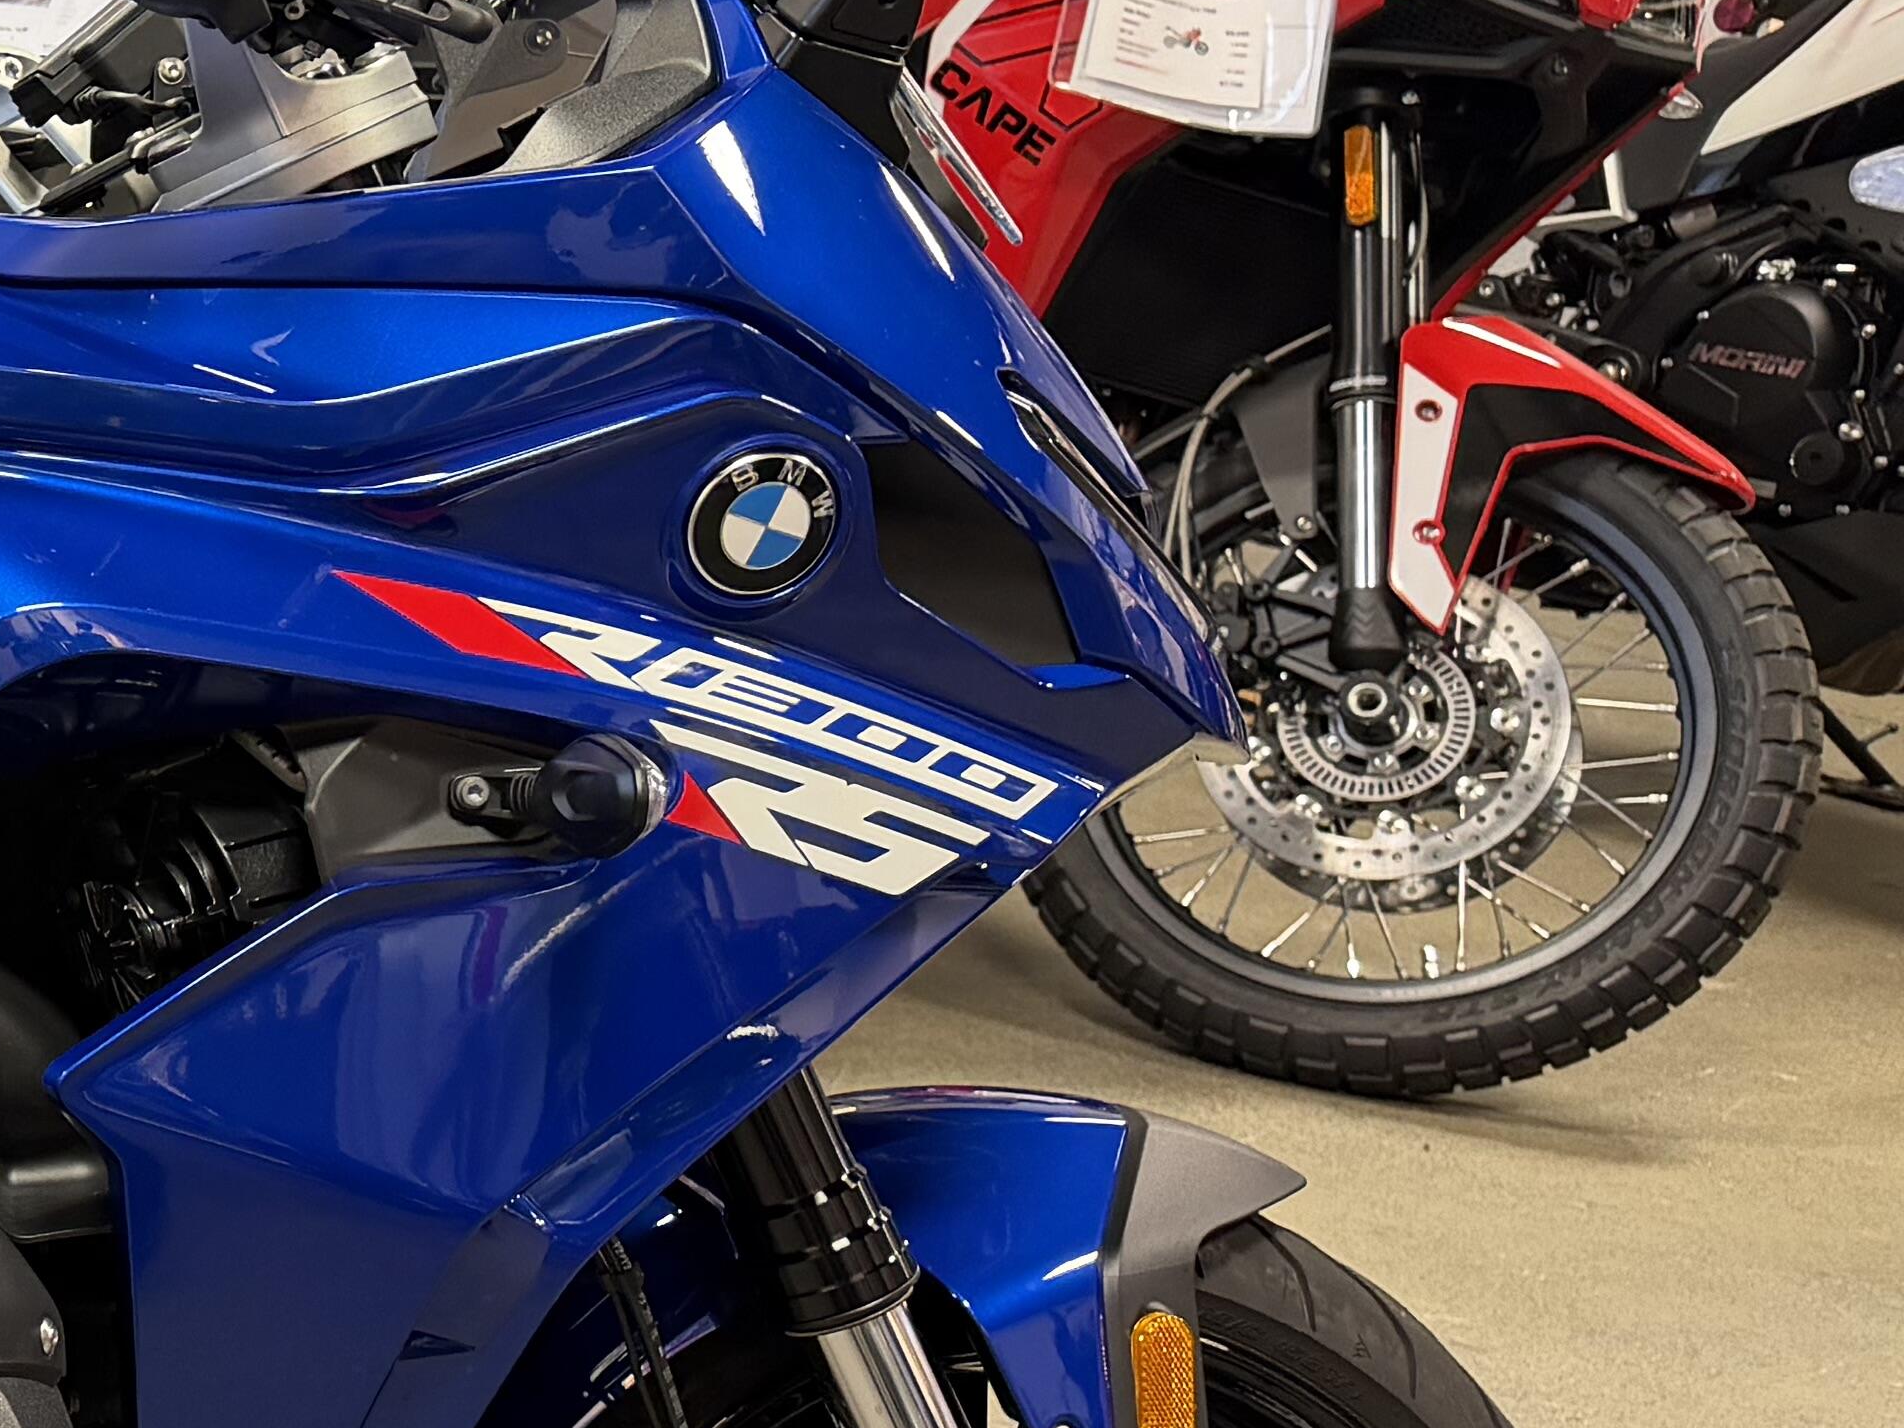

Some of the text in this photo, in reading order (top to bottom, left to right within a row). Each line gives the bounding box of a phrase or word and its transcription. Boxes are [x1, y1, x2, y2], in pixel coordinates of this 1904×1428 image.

[930, 59, 1056, 166] CAPE
[730, 459, 835, 519] BMW
[649, 718, 991, 896] RS
